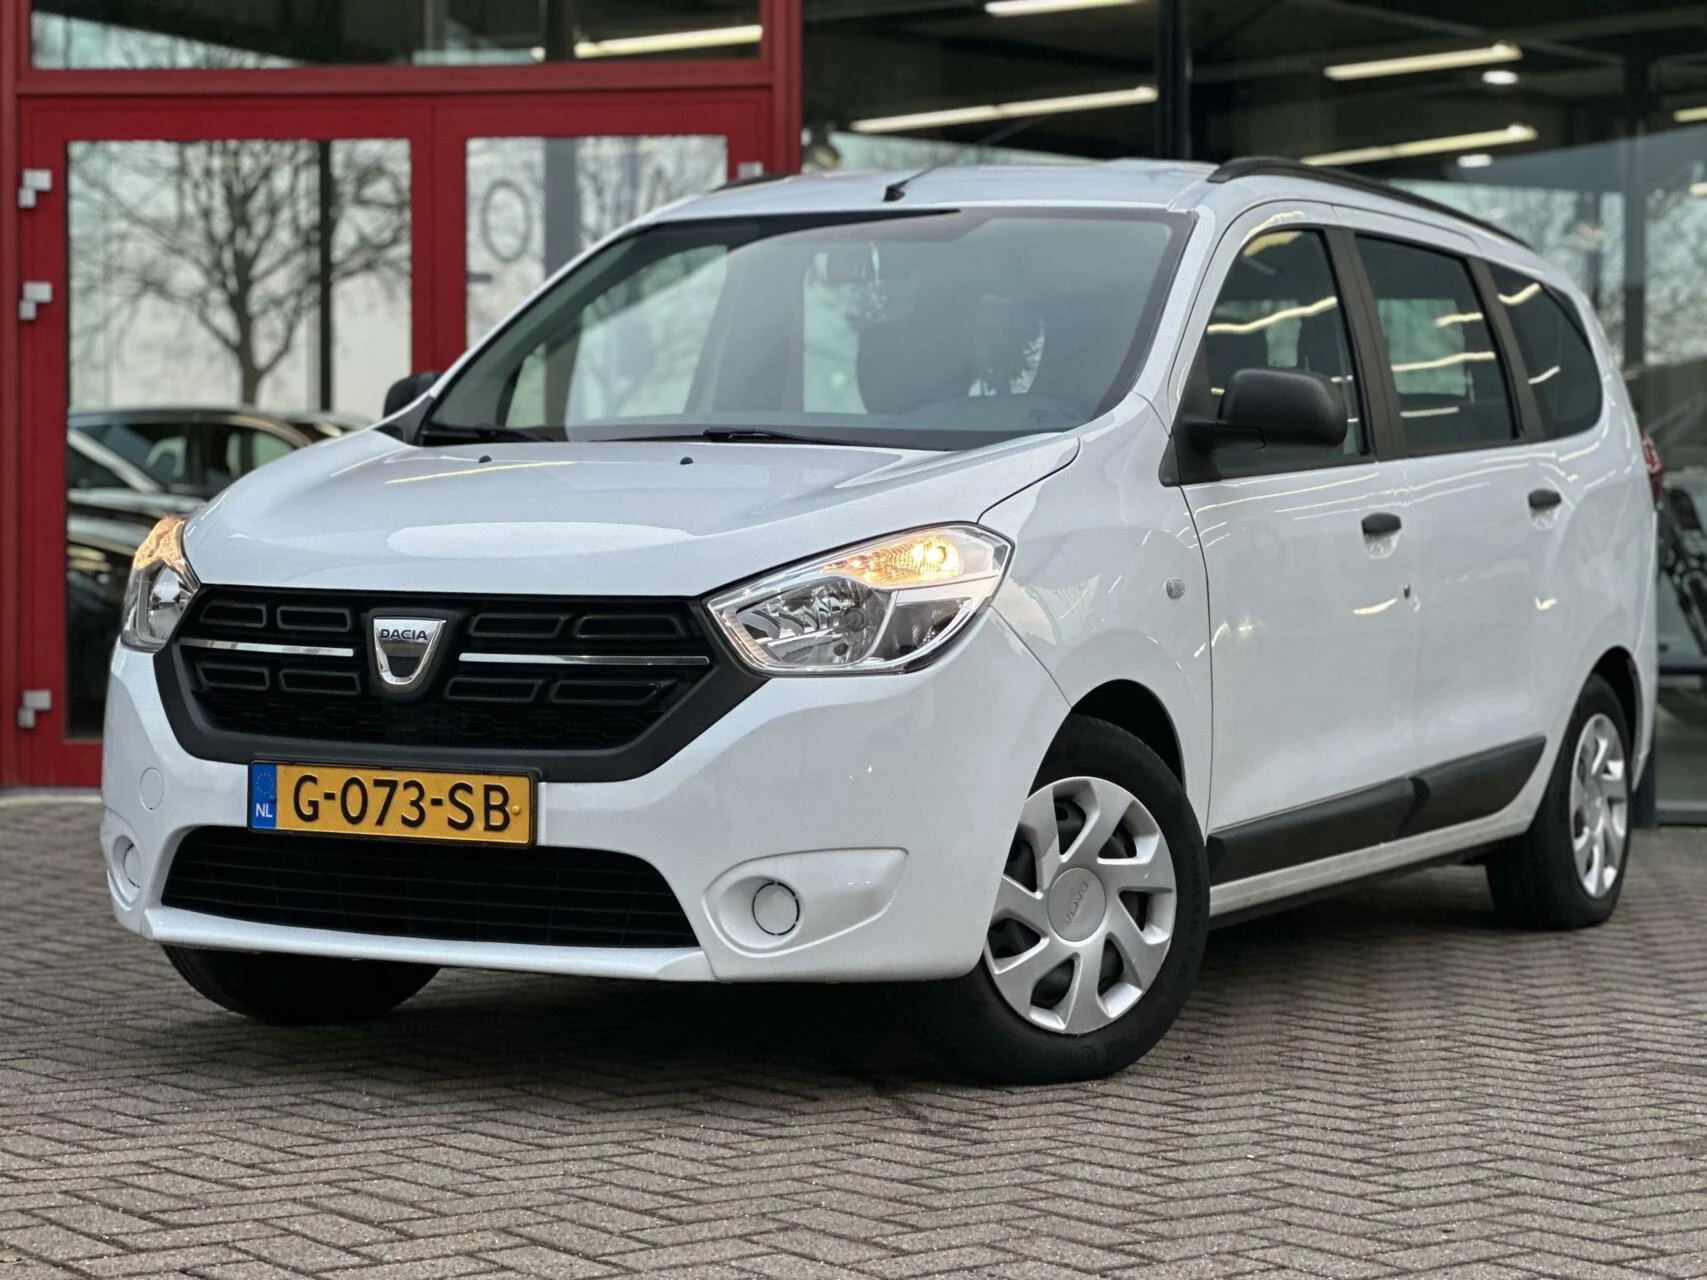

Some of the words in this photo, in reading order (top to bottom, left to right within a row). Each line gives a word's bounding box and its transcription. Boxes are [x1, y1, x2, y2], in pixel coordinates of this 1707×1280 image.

[380, 629, 428, 640] DACIA
[255, 803, 273, 817] NL
[293, 774, 511, 832] G-073-SB
